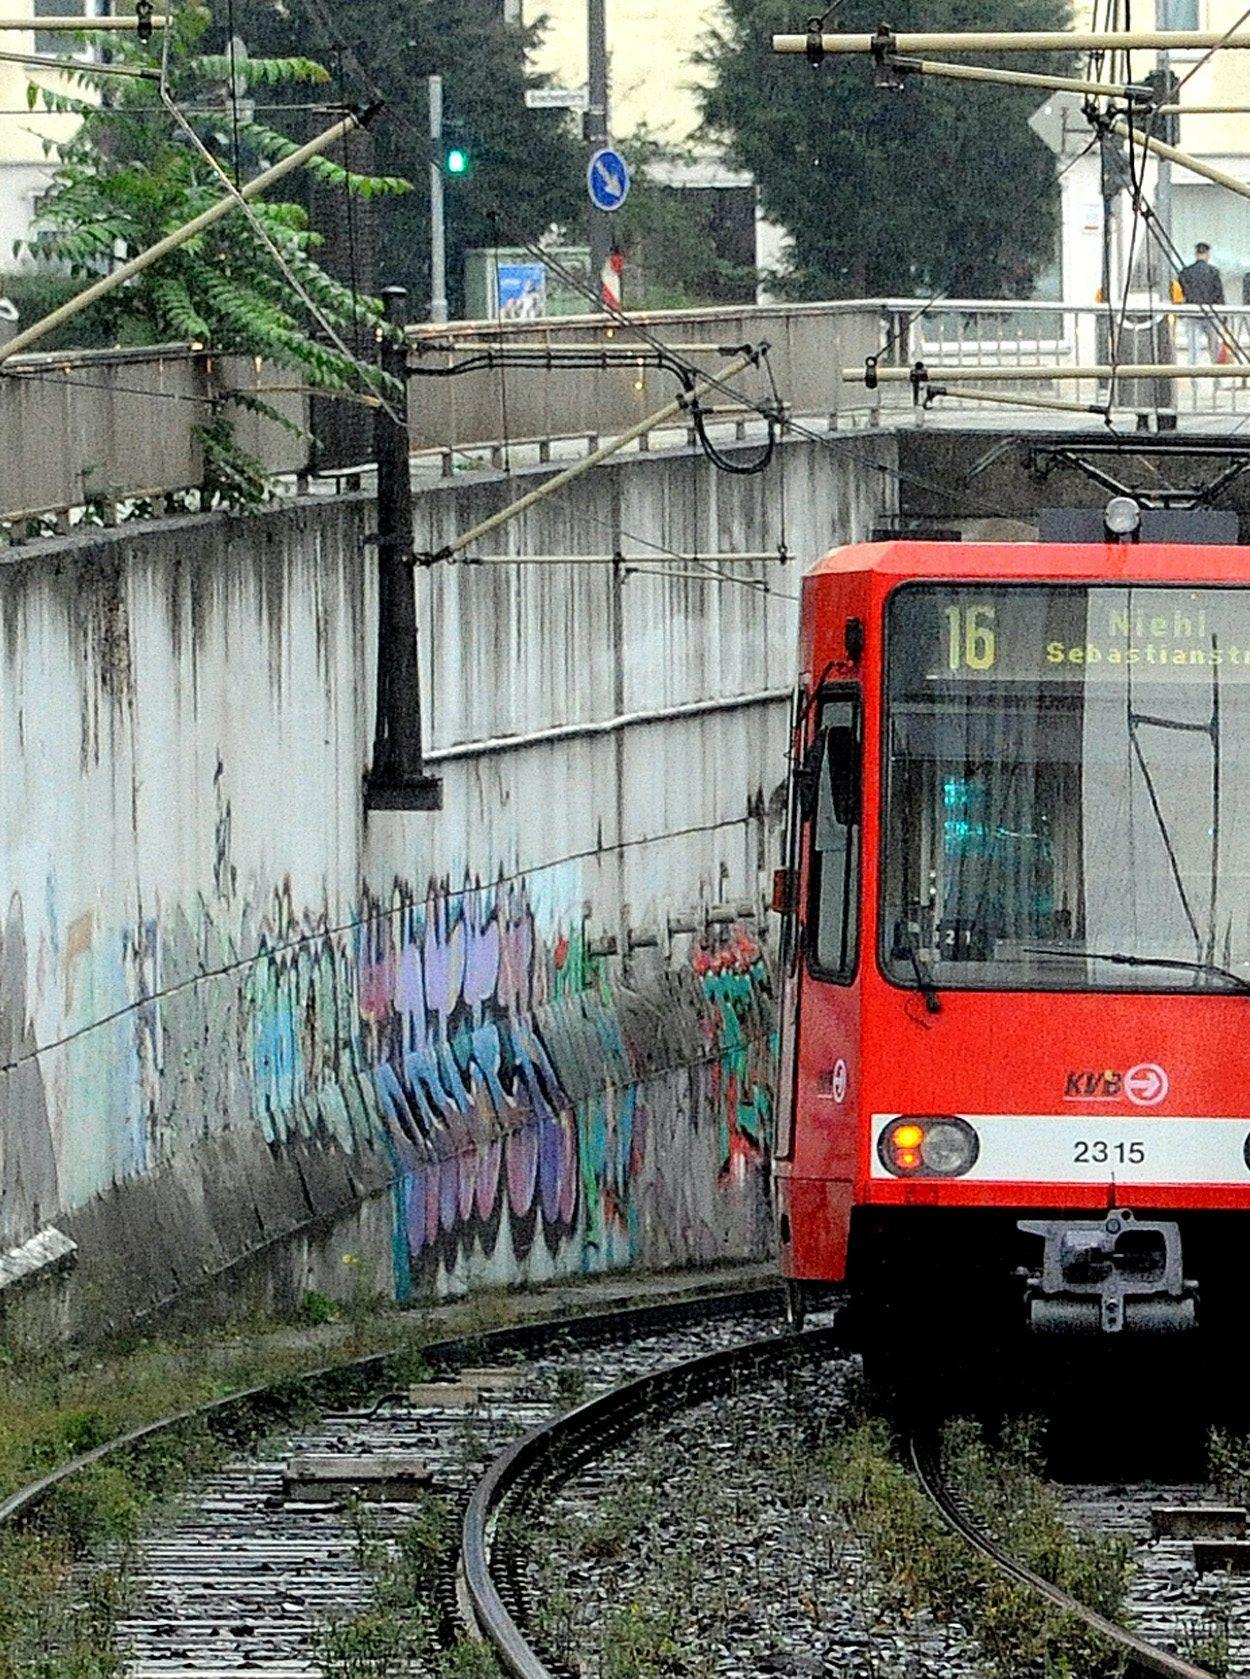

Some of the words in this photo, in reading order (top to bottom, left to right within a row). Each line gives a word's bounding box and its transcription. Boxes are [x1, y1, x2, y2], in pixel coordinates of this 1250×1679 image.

[1108, 609, 1206, 637] Niehl
[945, 604, 996, 671] 16
[1064, 1070, 1122, 1097] KVB
[1073, 1141, 1145, 1163] 2315
